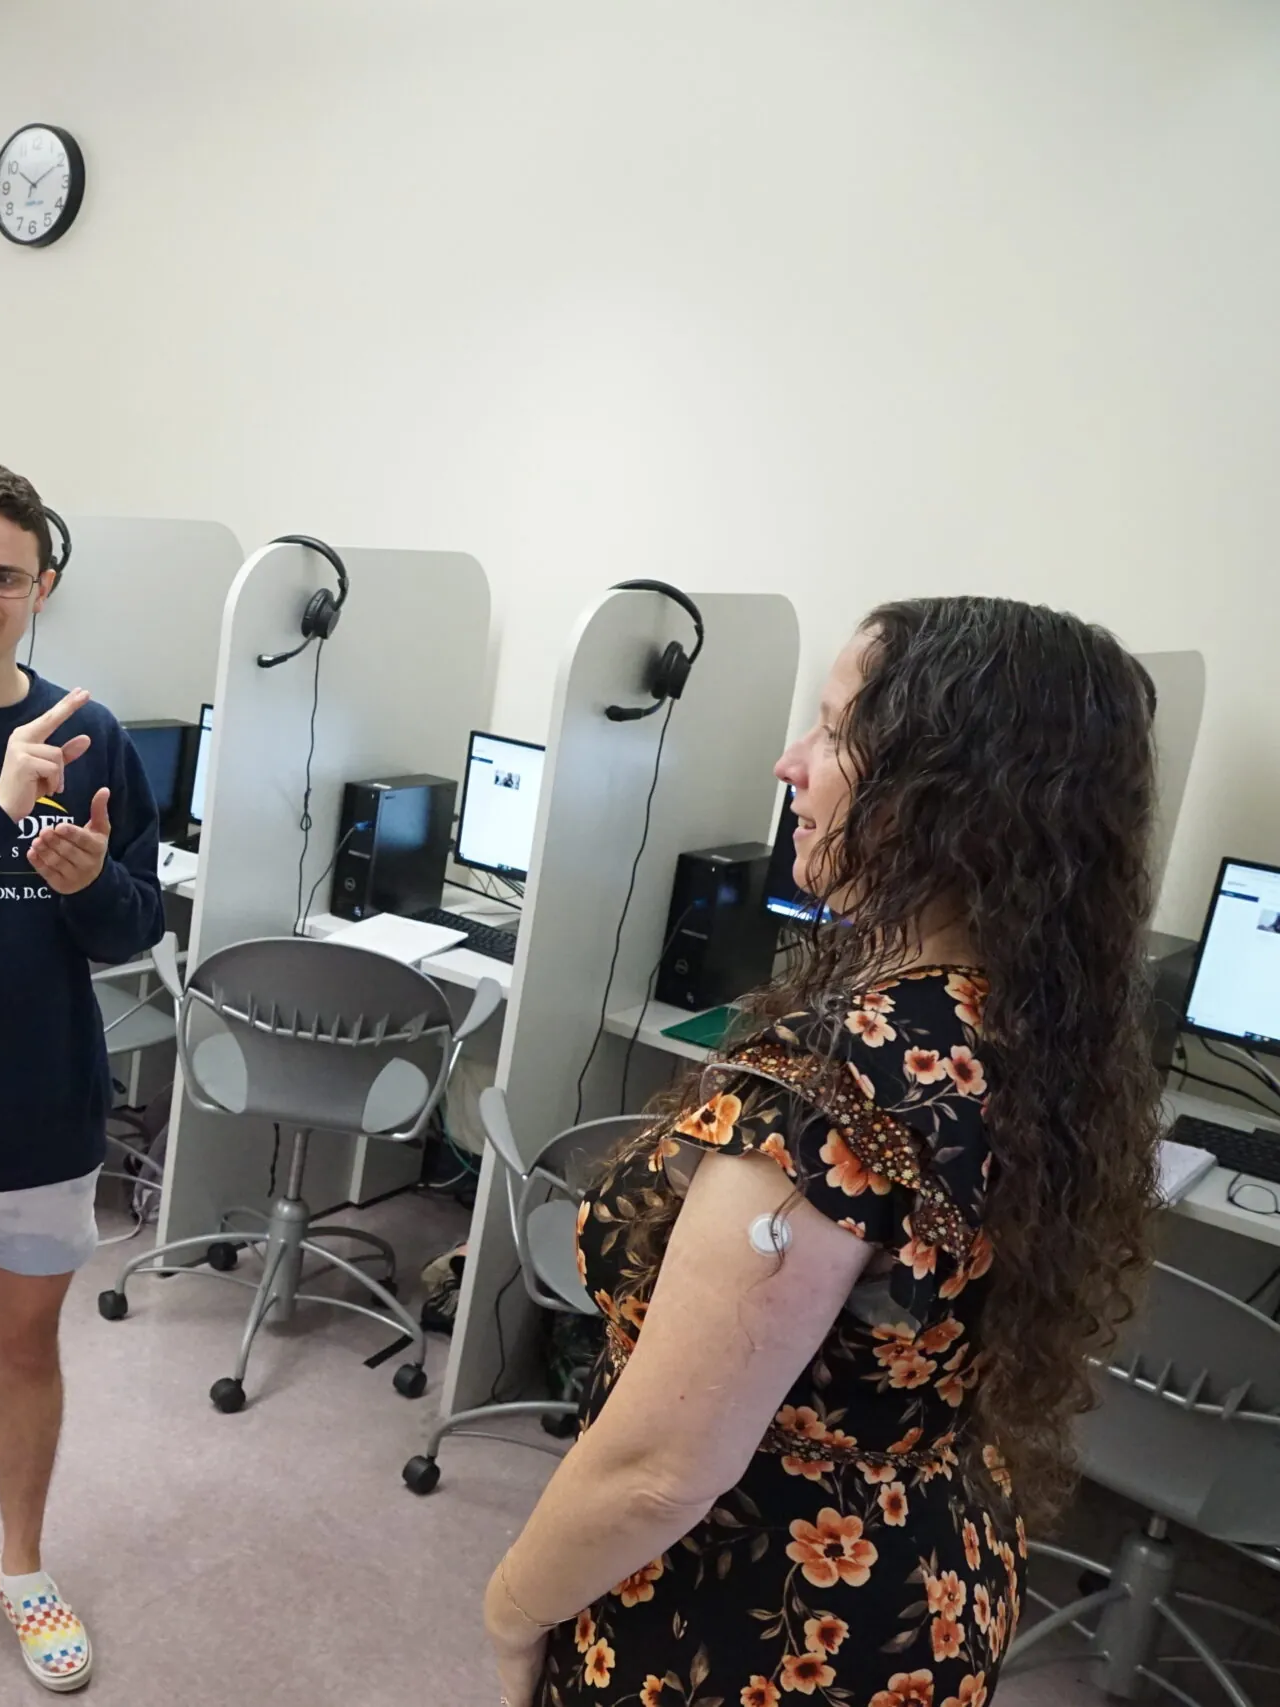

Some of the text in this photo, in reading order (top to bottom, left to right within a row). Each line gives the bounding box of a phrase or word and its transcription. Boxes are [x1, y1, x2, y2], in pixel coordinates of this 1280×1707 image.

[20, 143, 28, 157] 11
[32, 136, 43, 151] 12
[57, 153, 65, 167] 2
[8, 160, 19, 175] 10
[2, 181, 11, 196] 9
[62, 175, 69, 189] 3
[5, 202, 14, 216] 8
[55, 196, 65, 210] 4
[16, 216, 24, 231] 7
[43, 212, 53, 228] 5
[28, 220, 38, 235] 6
[23, 886, 52, 900] D.C.
